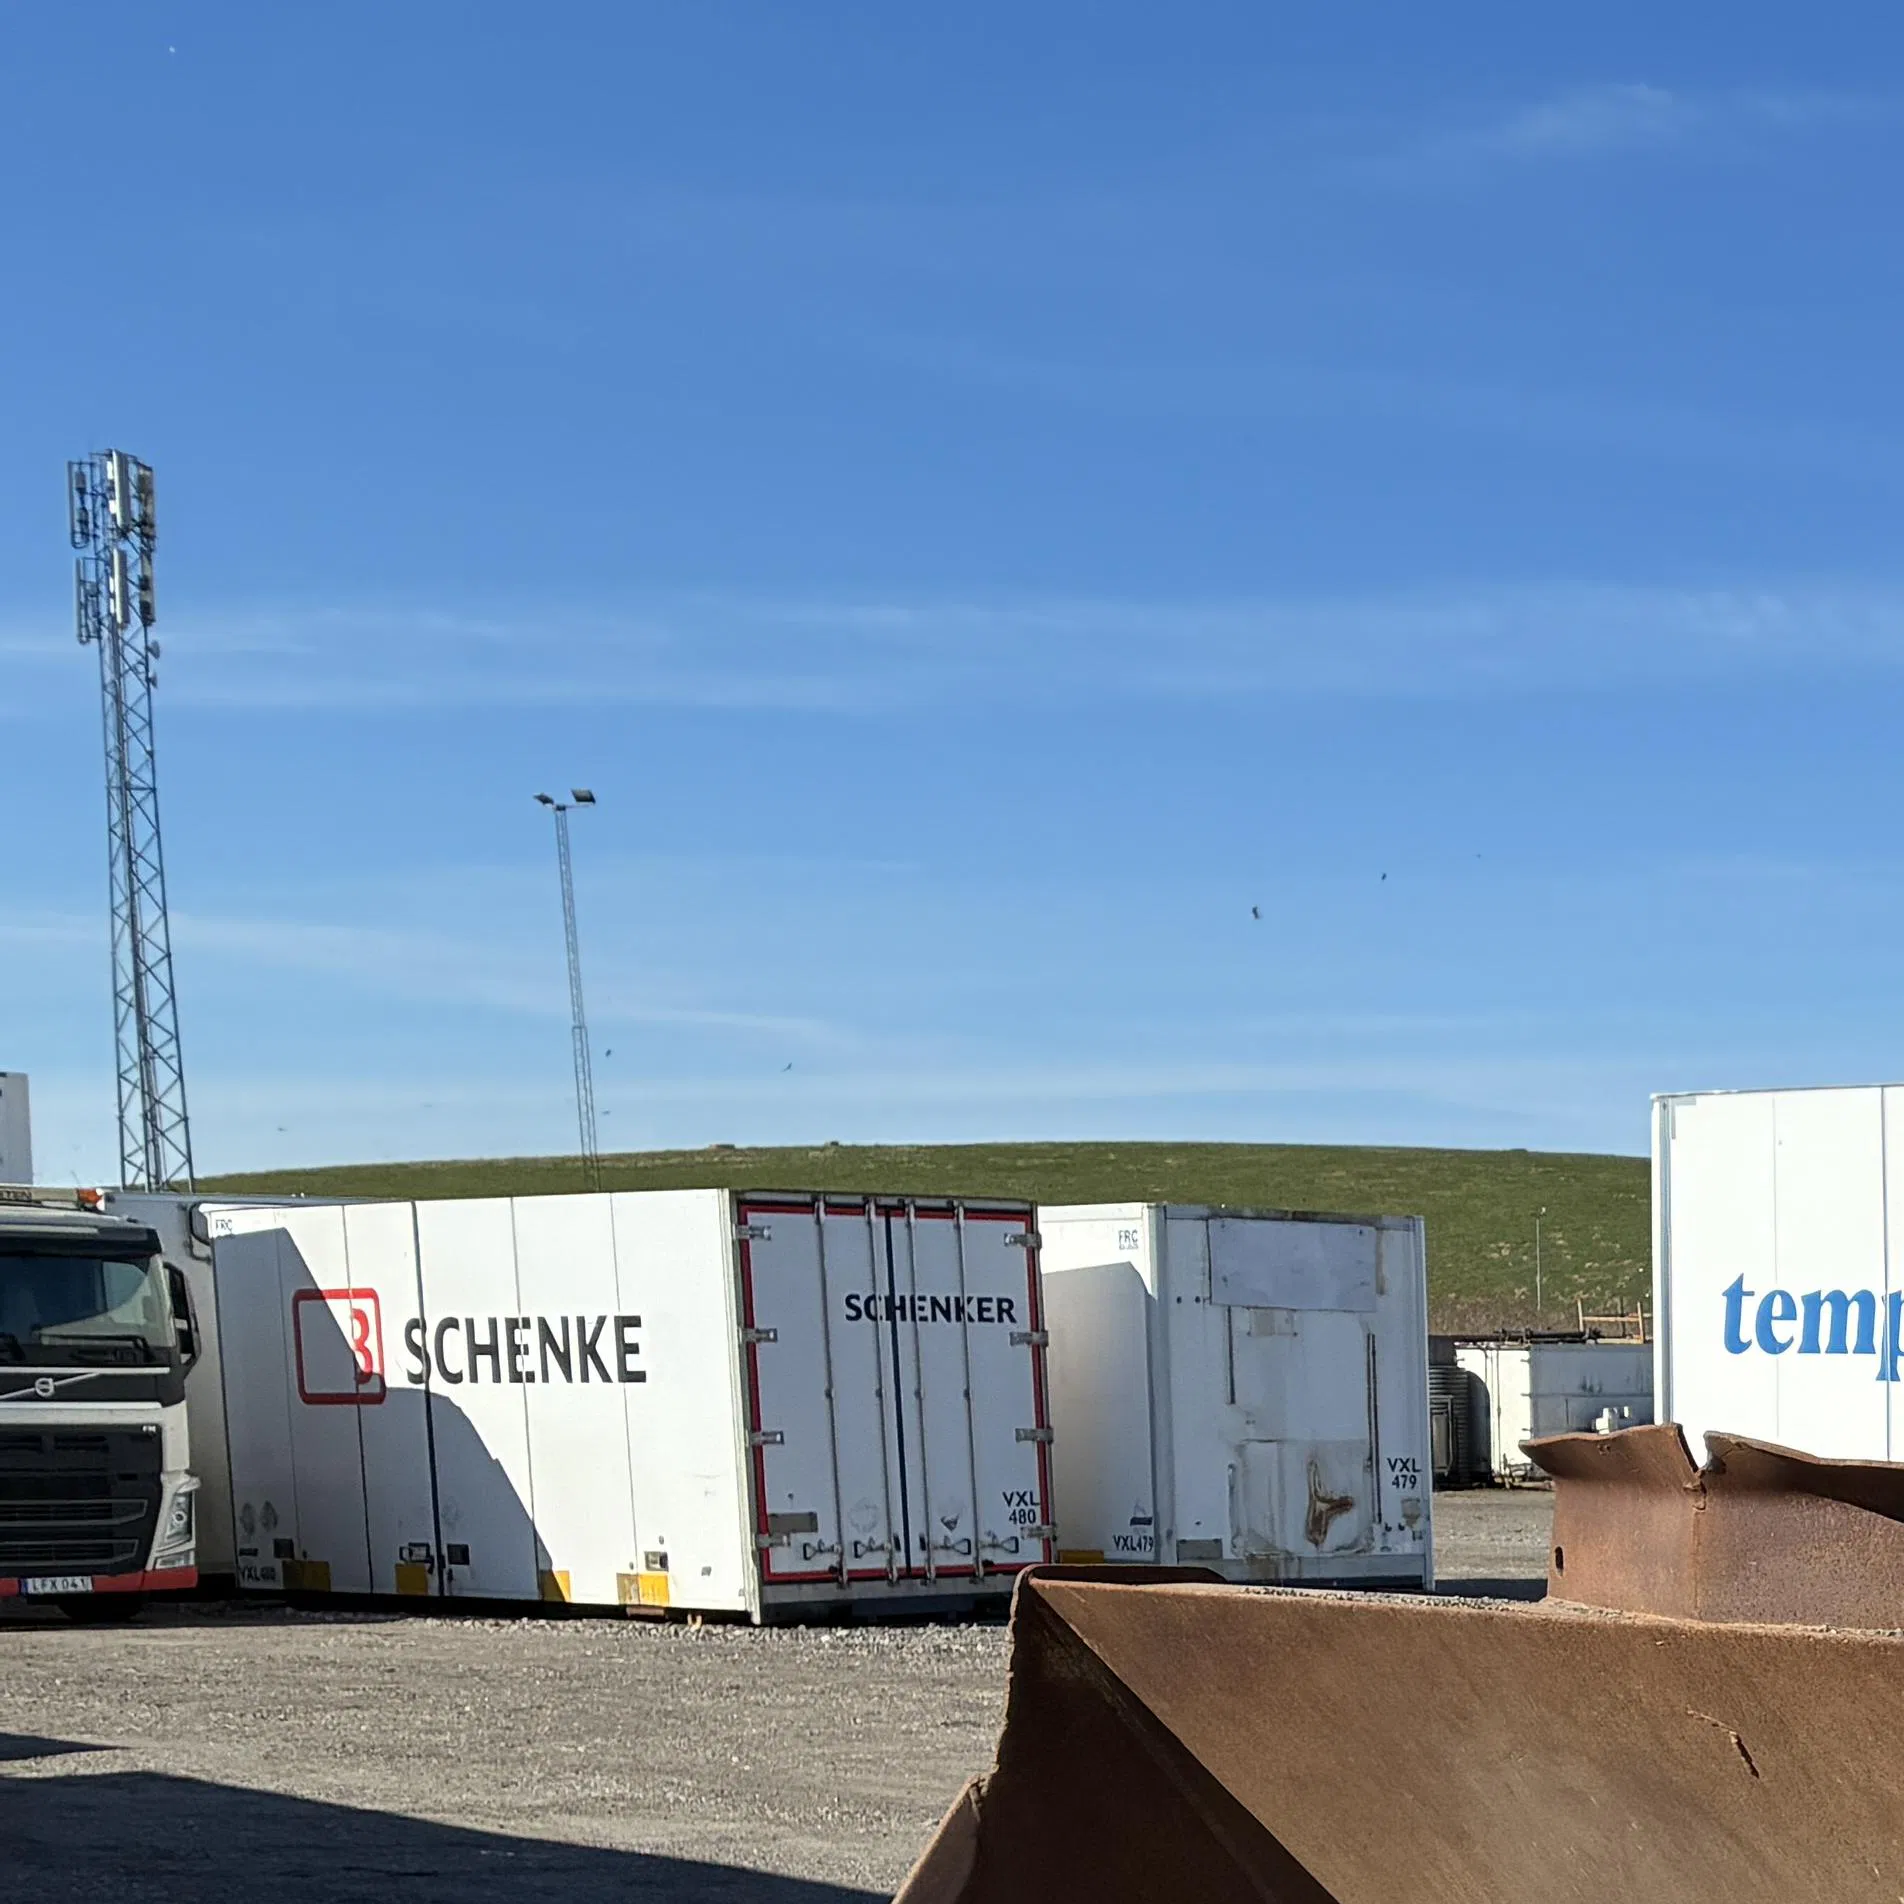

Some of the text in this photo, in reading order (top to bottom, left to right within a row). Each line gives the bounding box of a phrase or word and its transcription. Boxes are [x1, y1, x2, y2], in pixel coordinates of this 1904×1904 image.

[845, 1294, 1017, 1323] SCHENKER
[404, 1315, 647, 1384] SCHENKE
[1386, 1457, 1421, 1472] VXL
[1391, 1474, 1417, 1489] 479
[1002, 1491, 1040, 1507] VXL
[1009, 1509, 1036, 1524] 480
